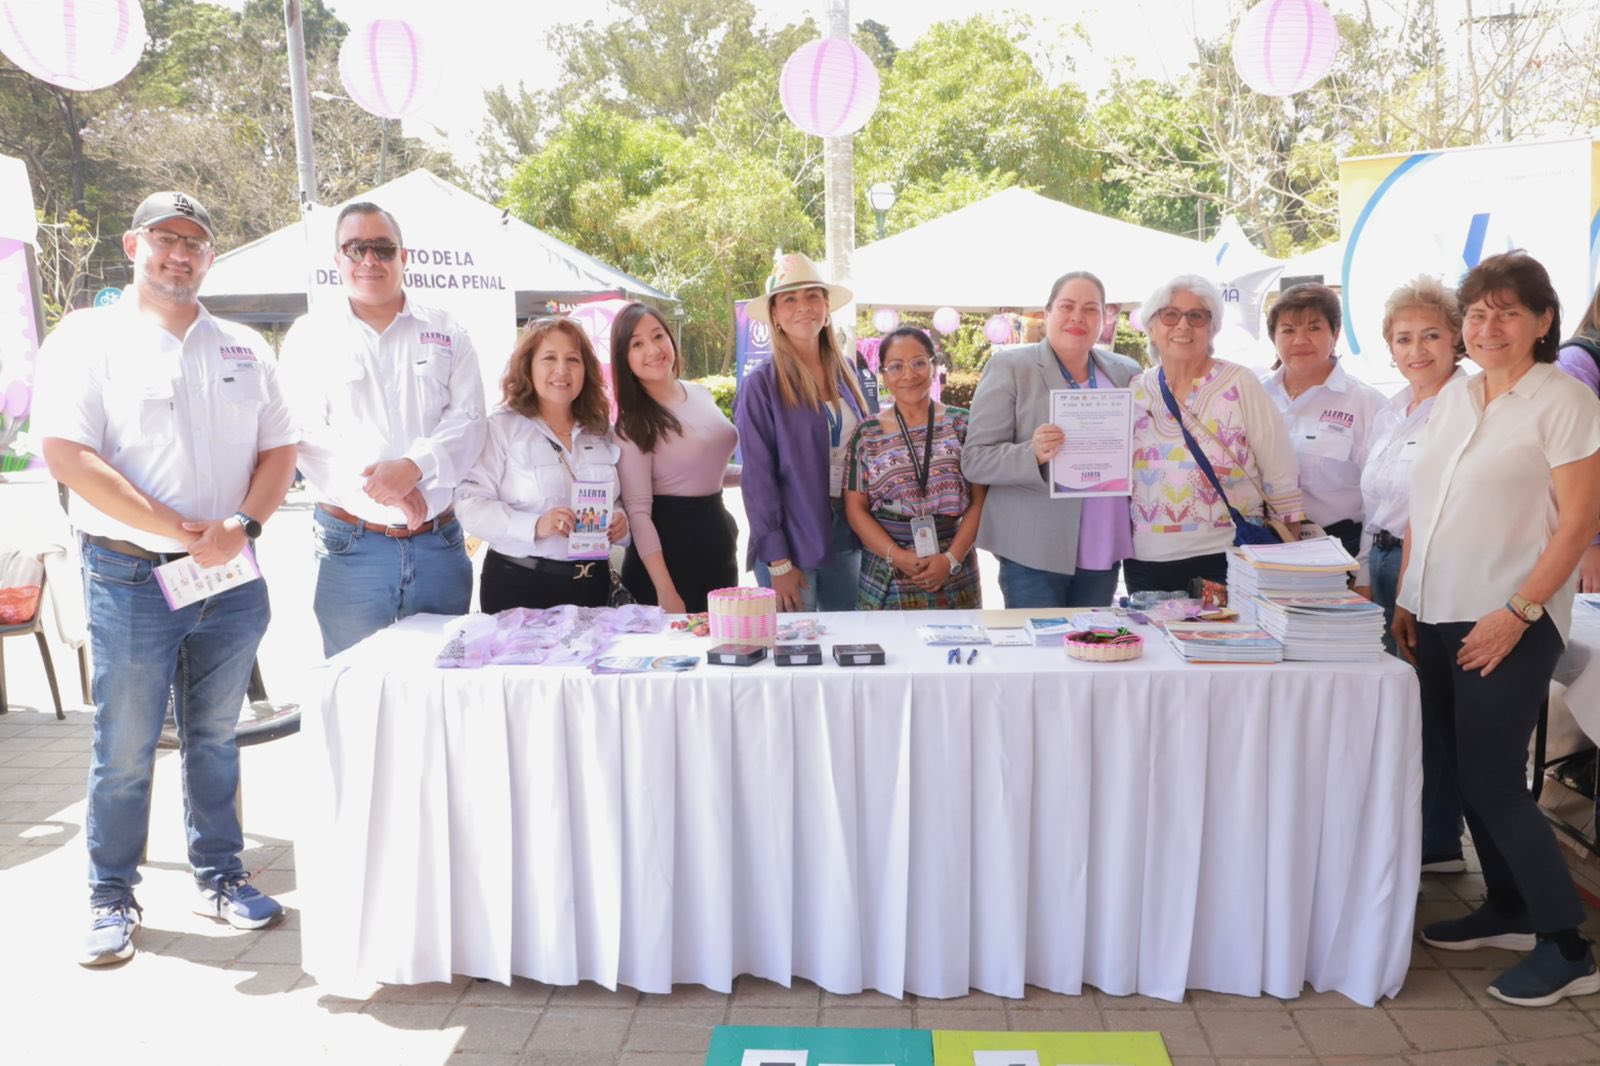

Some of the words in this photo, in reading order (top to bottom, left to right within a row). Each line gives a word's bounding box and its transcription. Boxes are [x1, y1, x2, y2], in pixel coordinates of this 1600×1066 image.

[433, 251, 452, 266] DE
[456, 252, 474, 266] LA
[462, 275, 506, 290] PENAL
[1321, 410, 1354, 422] ALERTA
[578, 489, 607, 498] ALERTA
